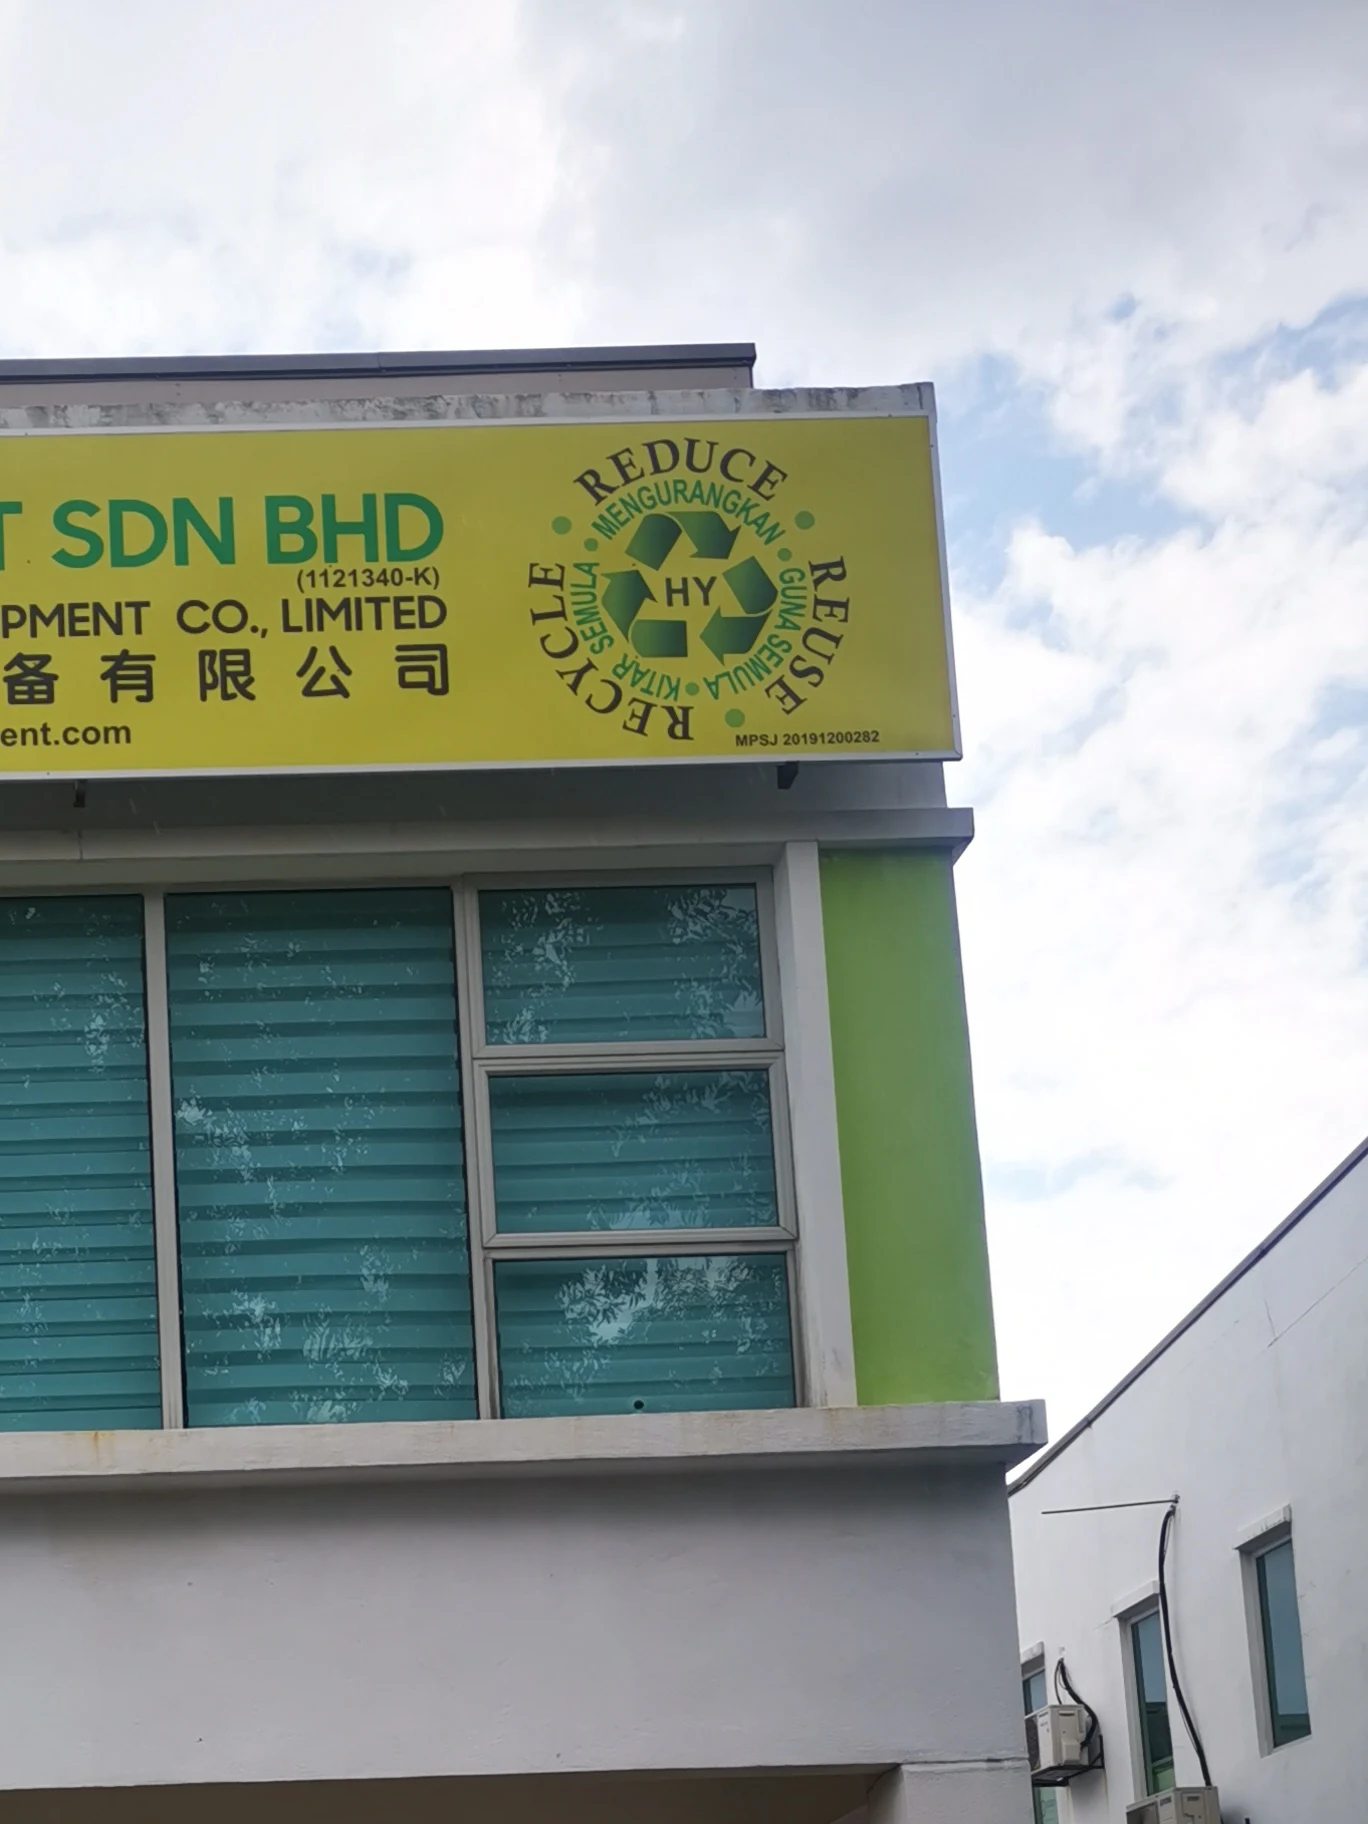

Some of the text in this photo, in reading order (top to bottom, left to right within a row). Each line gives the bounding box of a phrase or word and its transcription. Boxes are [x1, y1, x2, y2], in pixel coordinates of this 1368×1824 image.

[573, 437, 788, 506] REDUCE
[50, 496, 236, 569] SDN
[264, 492, 444, 565] BHD
[590, 479, 786, 546] MENGURANGKAN
[297, 566, 440, 593] (1121340-K)
[665, 576, 717, 607] HY
[176, 599, 268, 639] CO.,
[281, 595, 447, 633] LIMITED
[528, 562, 695, 741] RECYCLE
[570, 561, 681, 701] KITAR SEMULA
[702, 567, 808, 700] GUNA SEMULA
[764, 555, 850, 715] REUSE
[735, 730, 880, 747] MPSJ 20191200282
